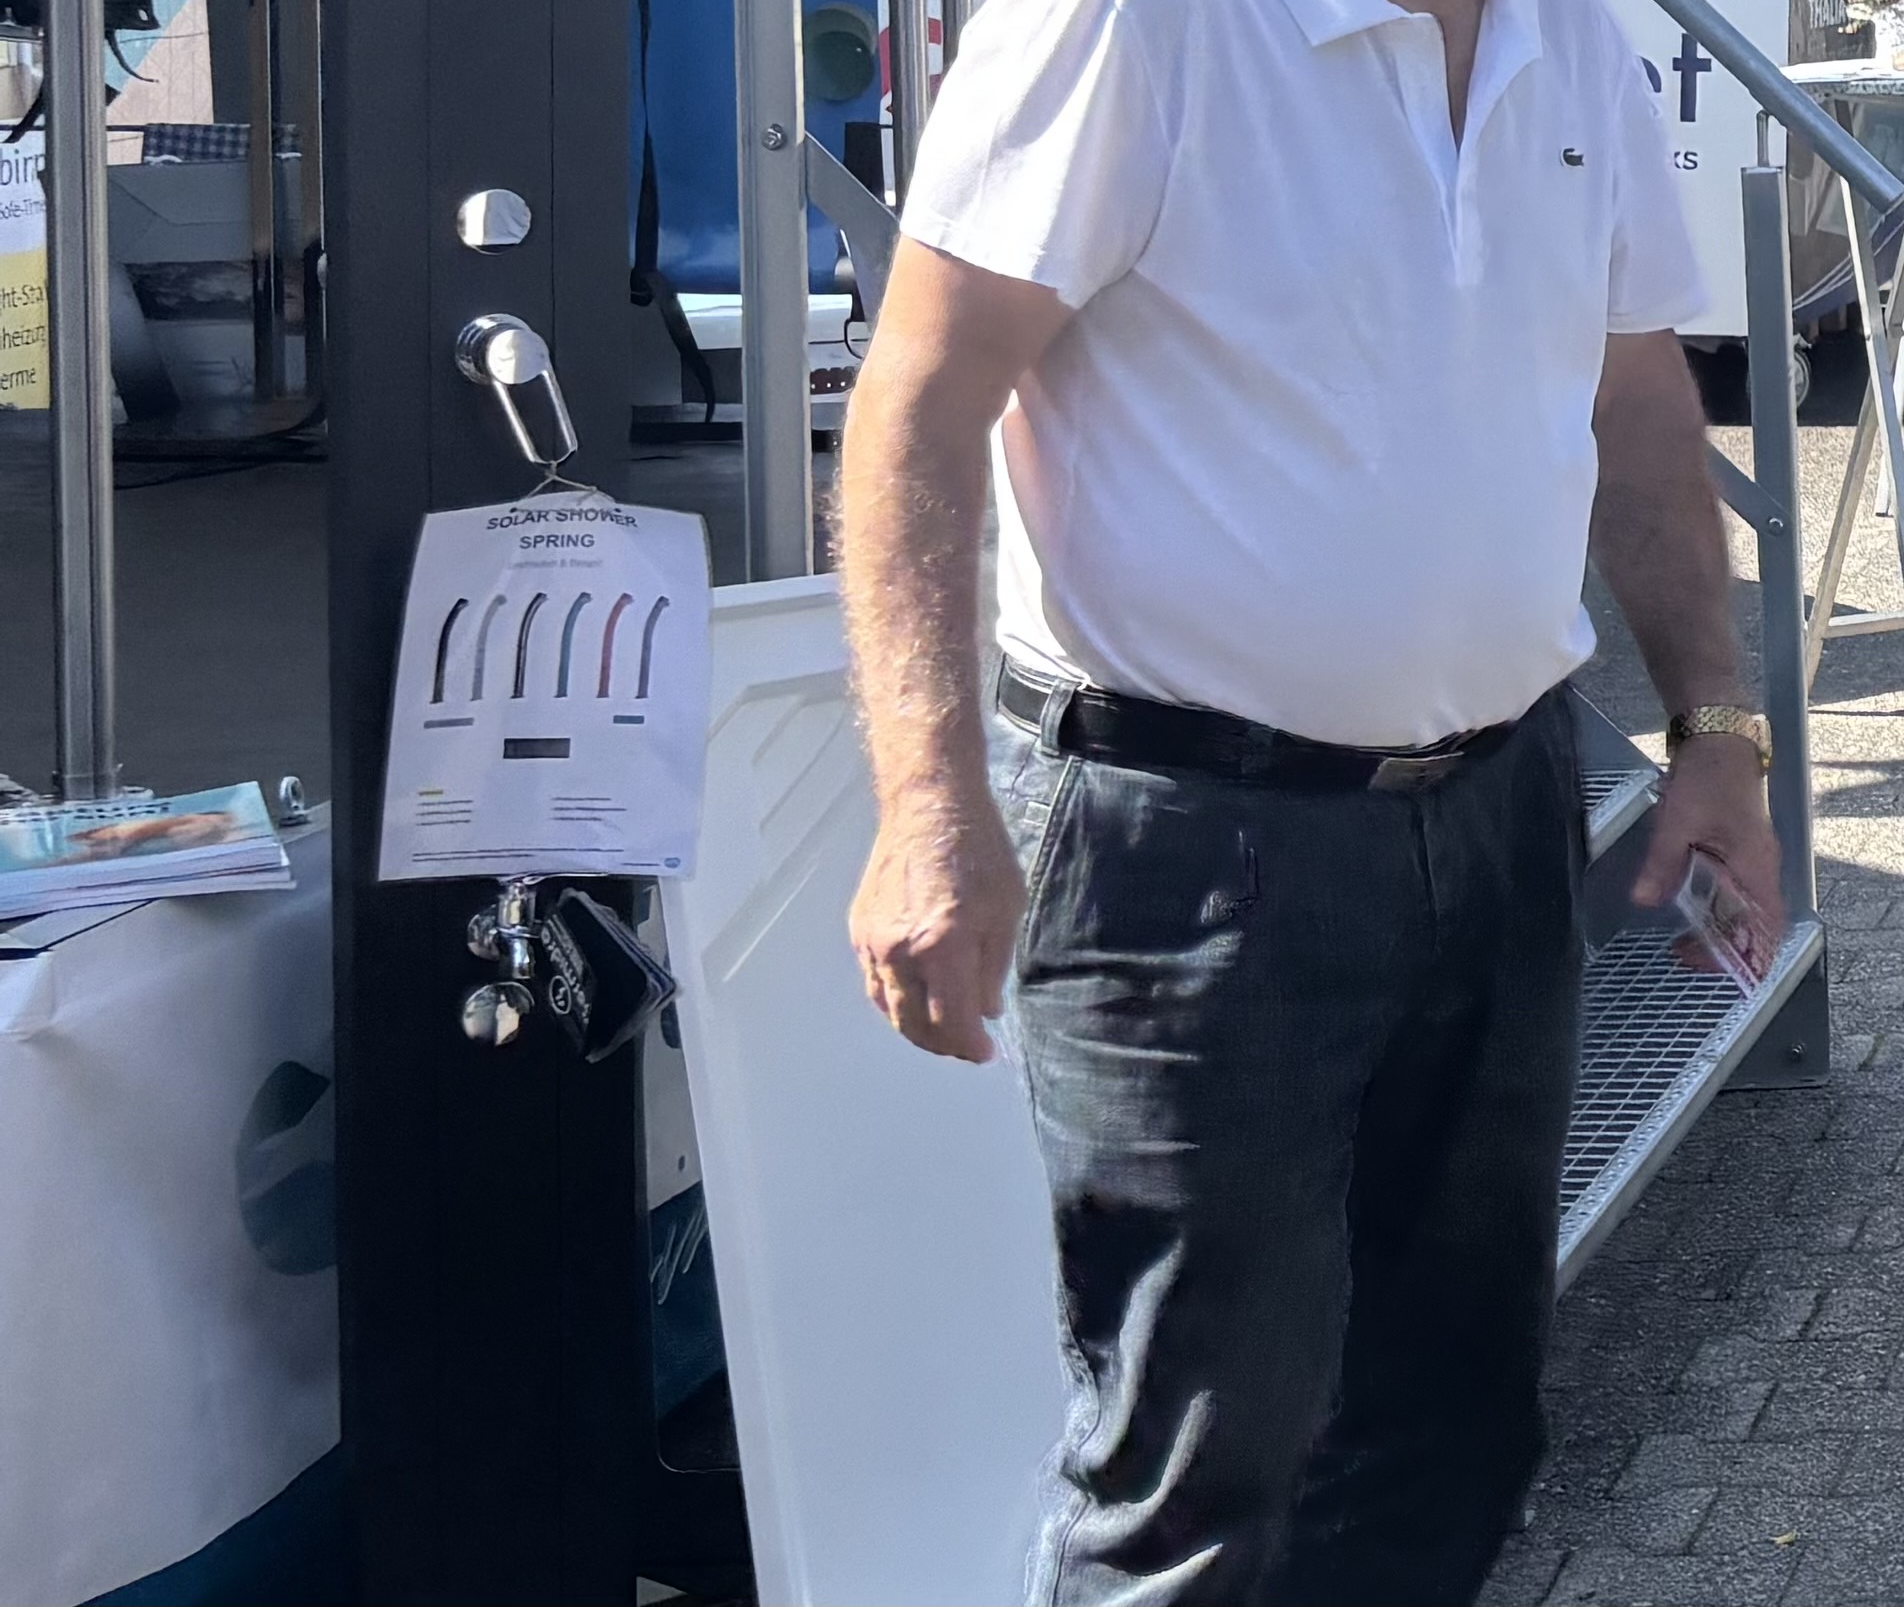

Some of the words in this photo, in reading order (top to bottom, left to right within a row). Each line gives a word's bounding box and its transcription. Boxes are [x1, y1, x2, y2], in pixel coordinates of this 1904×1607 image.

[486, 509, 550, 531] SOLAR
[555, 507, 639, 529] SHOWER
[519, 533, 596, 549] SPRING
